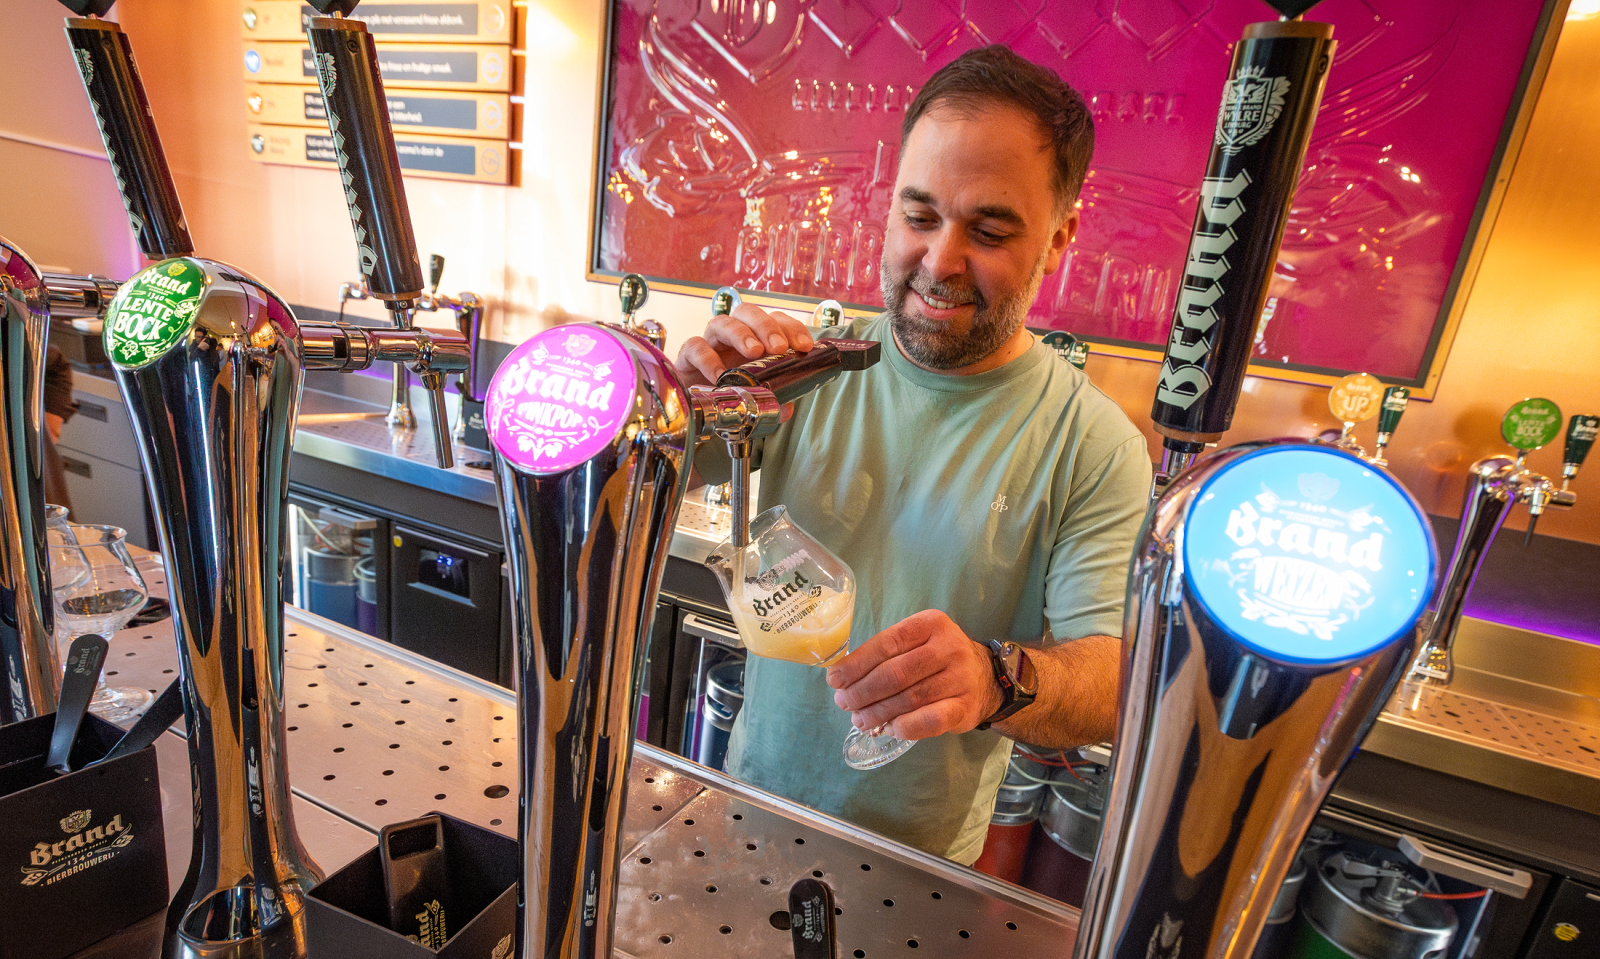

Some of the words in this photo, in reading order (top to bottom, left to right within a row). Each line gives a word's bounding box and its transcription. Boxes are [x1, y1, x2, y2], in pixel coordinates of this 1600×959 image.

[140, 267, 192, 295] Brand
[147, 291, 166, 301] 1340
[1157, 168, 1253, 411] Brand
[120, 296, 174, 321] LENTE
[114, 311, 168, 341] BOCK
[502, 356, 615, 411] Brand
[516, 401, 583, 429] PINKPOP
[1343, 396, 1369, 413] UP
[1225, 501, 1384, 572] Brand
[752, 571, 809, 617] Brand
[1253, 556, 1346, 610] WEIZEN
[776, 602, 818, 634] BIERBROUWERIJ
[74, 648, 90, 674] Brand
[30, 814, 124, 866] Brand
[46, 851, 115, 886] BIERBROUWERIJ
[67, 851, 93, 866] 1340
[802, 901, 814, 938] Brand
